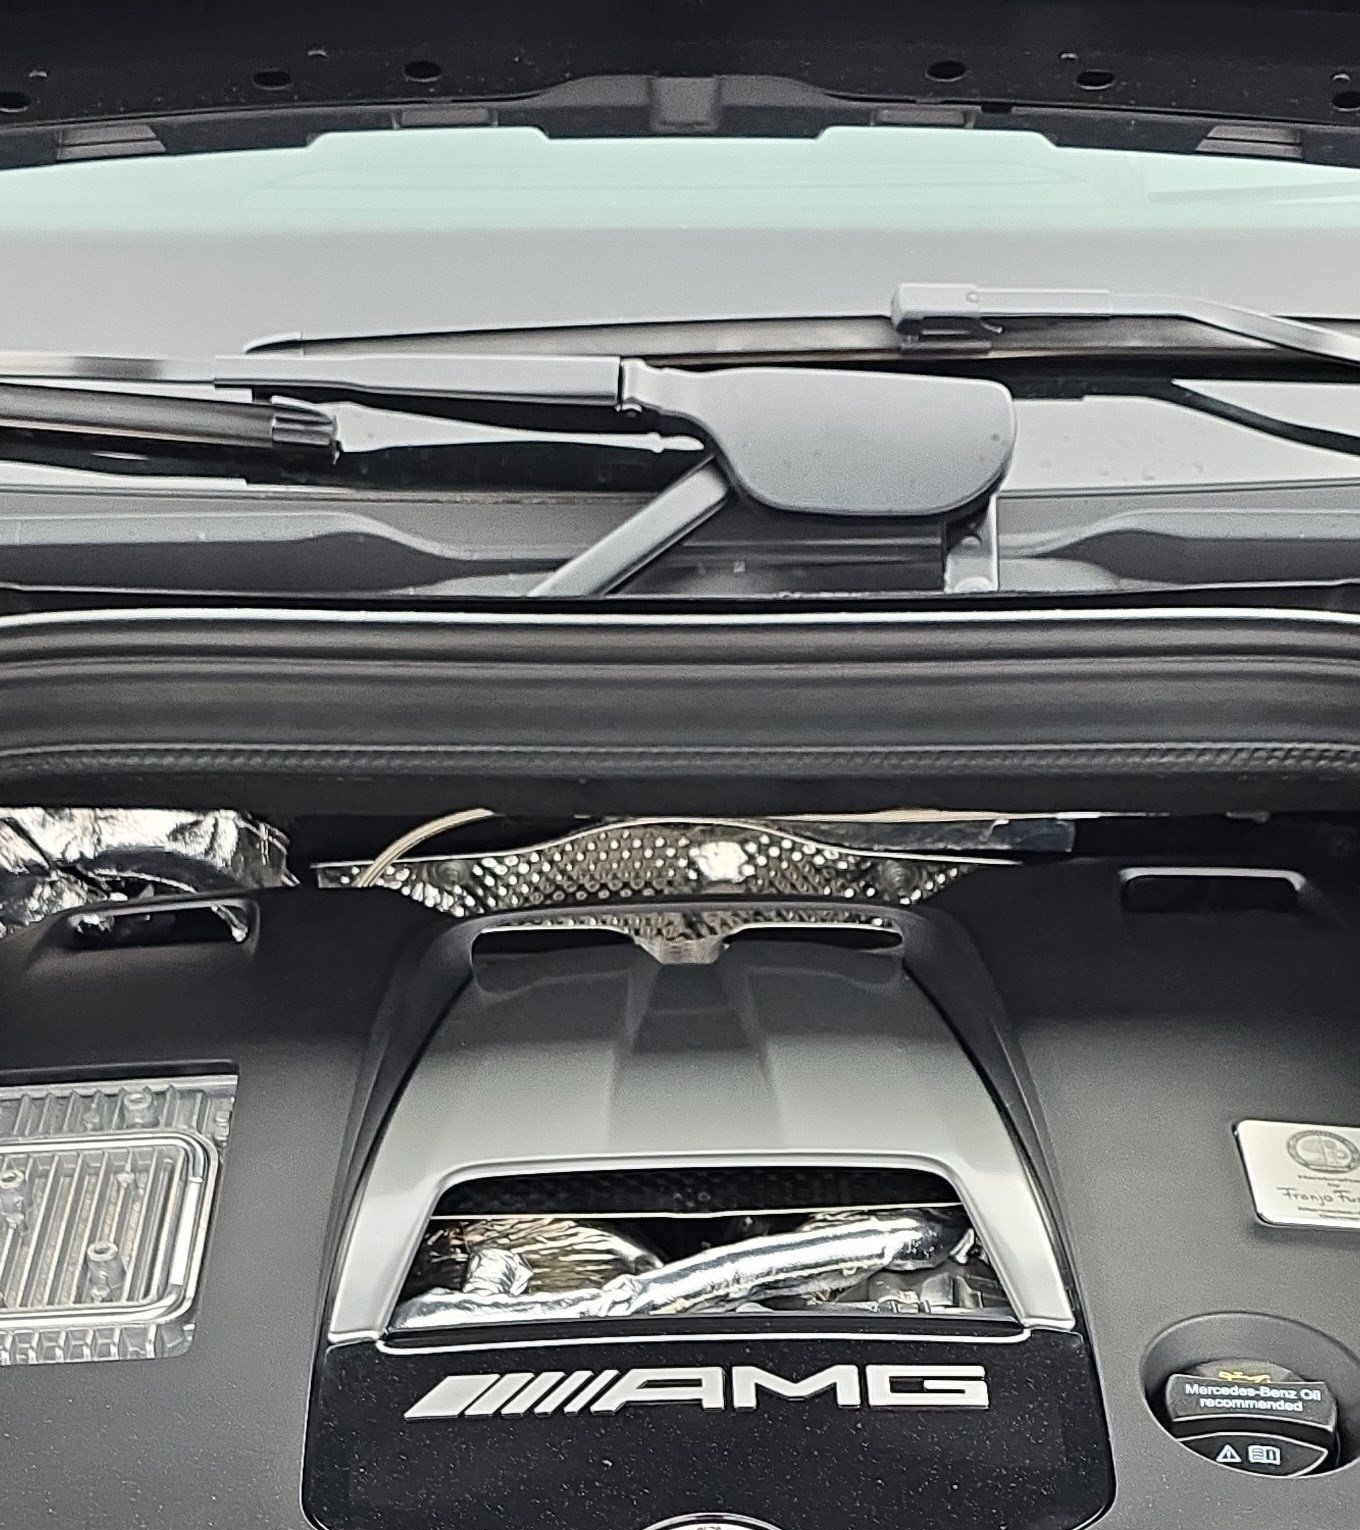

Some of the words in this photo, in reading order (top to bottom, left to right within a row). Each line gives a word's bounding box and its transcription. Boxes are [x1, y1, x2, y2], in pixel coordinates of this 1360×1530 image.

[590, 1364, 989, 1415] AMG
[1185, 1383, 1298, 1399] Mercedes-Benz
[1300, 1389, 1322, 1401] Oil
[1200, 1398, 1303, 1412] recommended
